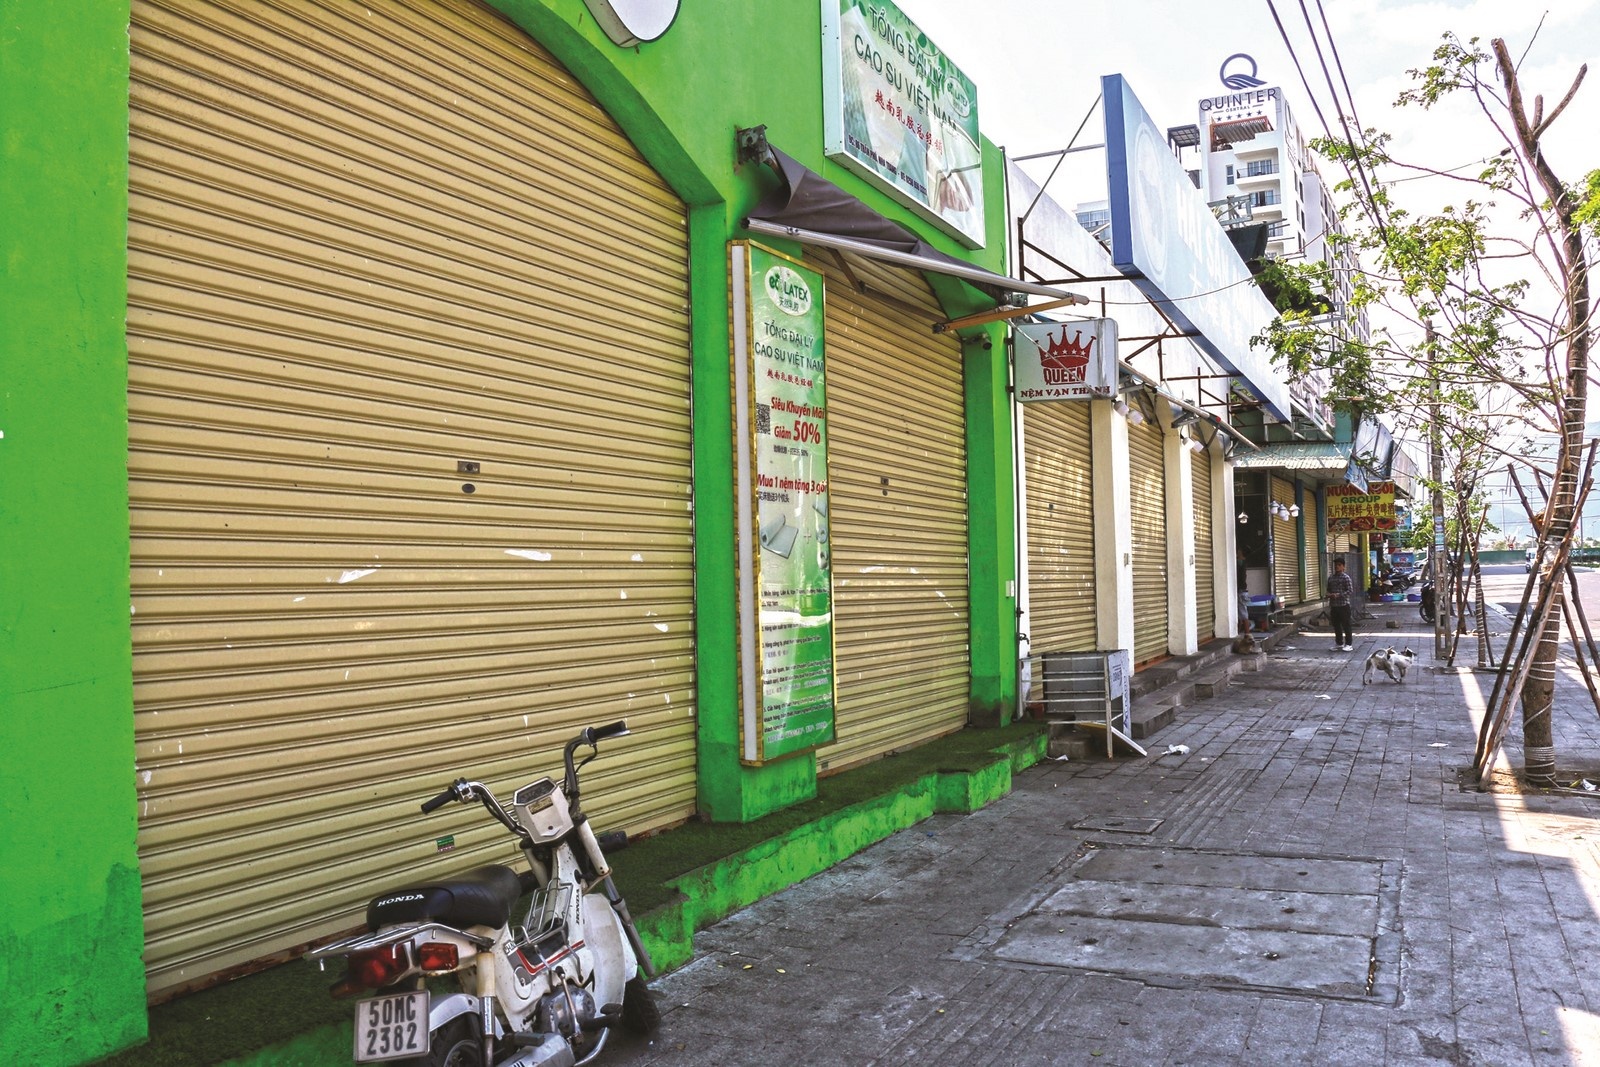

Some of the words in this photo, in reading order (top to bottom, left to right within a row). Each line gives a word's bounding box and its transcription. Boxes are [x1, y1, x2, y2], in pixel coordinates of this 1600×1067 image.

[869, 6, 905, 57] TỔNG
[854, 34, 882, 74] CAO
[885, 62, 902, 92] SU
[905, 78, 930, 116] VIỆT
[1199, 88, 1278, 111] QUINTER
[1225, 105, 1251, 113] CENTRAL
[783, 281, 808, 302] LATEX
[765, 320, 788, 340] TỔNG
[789, 330, 803, 348] ĐẠI
[804, 335, 813, 349] LÝ
[754, 342, 773, 358] CAO
[774, 348, 785, 361] SU
[787, 351, 804, 369] VIỆT
[806, 358, 824, 373] NAM
[1043, 365, 1087, 385] QUEEN
[1020, 388, 1043, 399] NỆM
[1045, 387, 1069, 397] VẠN
[771, 396, 786, 411] Siêu
[786, 400, 811, 418] Khuyến
[774, 425, 791, 440] Giảm
[793, 420, 821, 445] 50%
[757, 473, 773, 488] Mua
[775, 476, 778, 488] 1
[779, 477, 794, 493] nệm
[794, 478, 809, 494] tặng
[810, 480, 815, 492] 3
[1340, 495, 1381, 504] GROUP
[377, 893, 425, 908] HONDA
[366, 1022, 417, 1055] 2382
